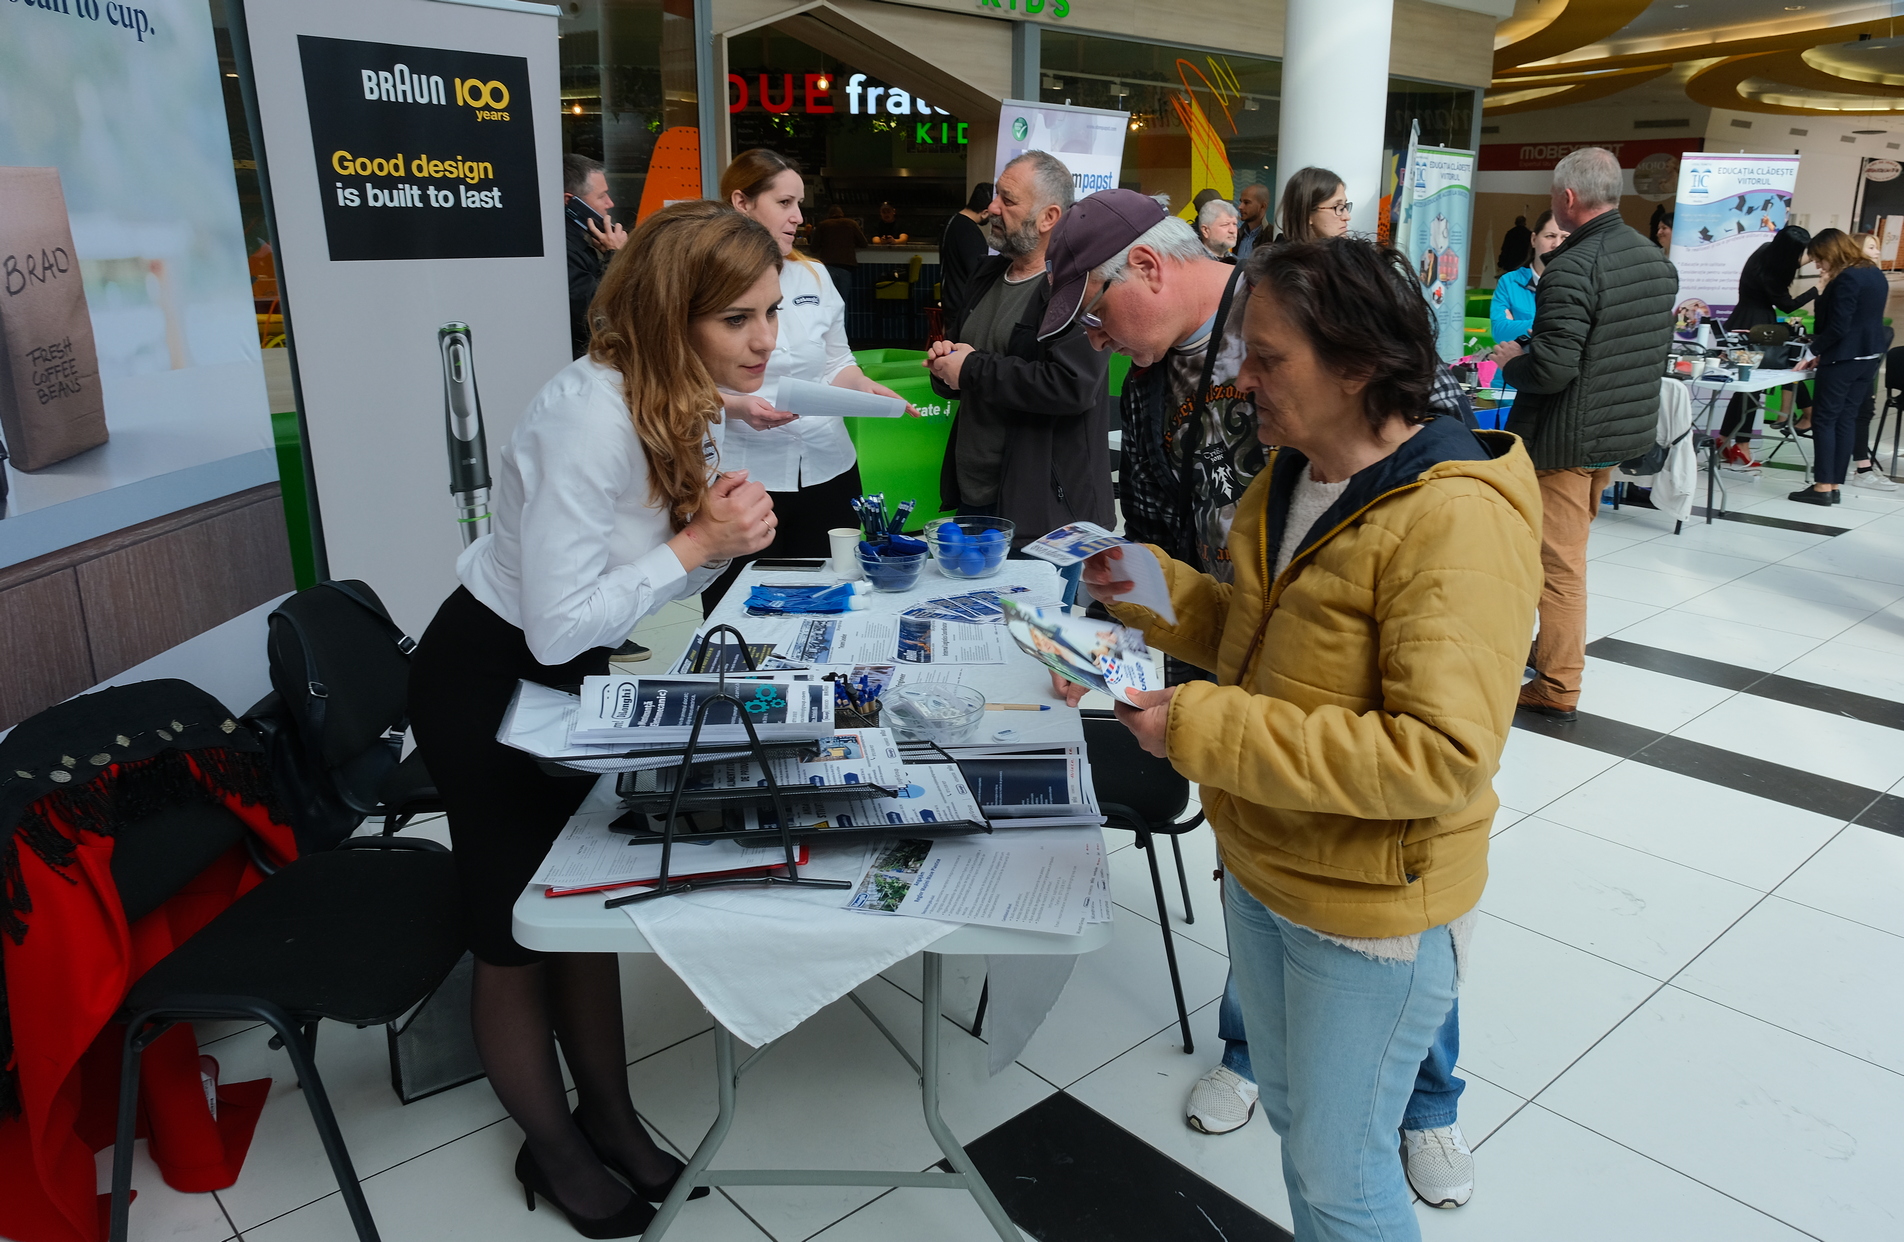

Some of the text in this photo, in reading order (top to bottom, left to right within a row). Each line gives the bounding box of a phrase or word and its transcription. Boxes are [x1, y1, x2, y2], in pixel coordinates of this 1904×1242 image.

[106, 1, 155, 43] cup.
[361, 63, 510, 109] BRAUN 100
[475, 109, 511, 122] years
[332, 150, 494, 184] Good design
[1718, 166, 1794, 178] EDUCAȚIA CLĂDEȘTE
[336, 182, 503, 209] is built to last
[1737, 177, 1772, 186] VIITORUL
[3, 247, 69, 297] BRAD
[26, 336, 72, 367] FRESH
[32, 358, 78, 386] COFFEE
[37, 380, 81, 405] BEANS
